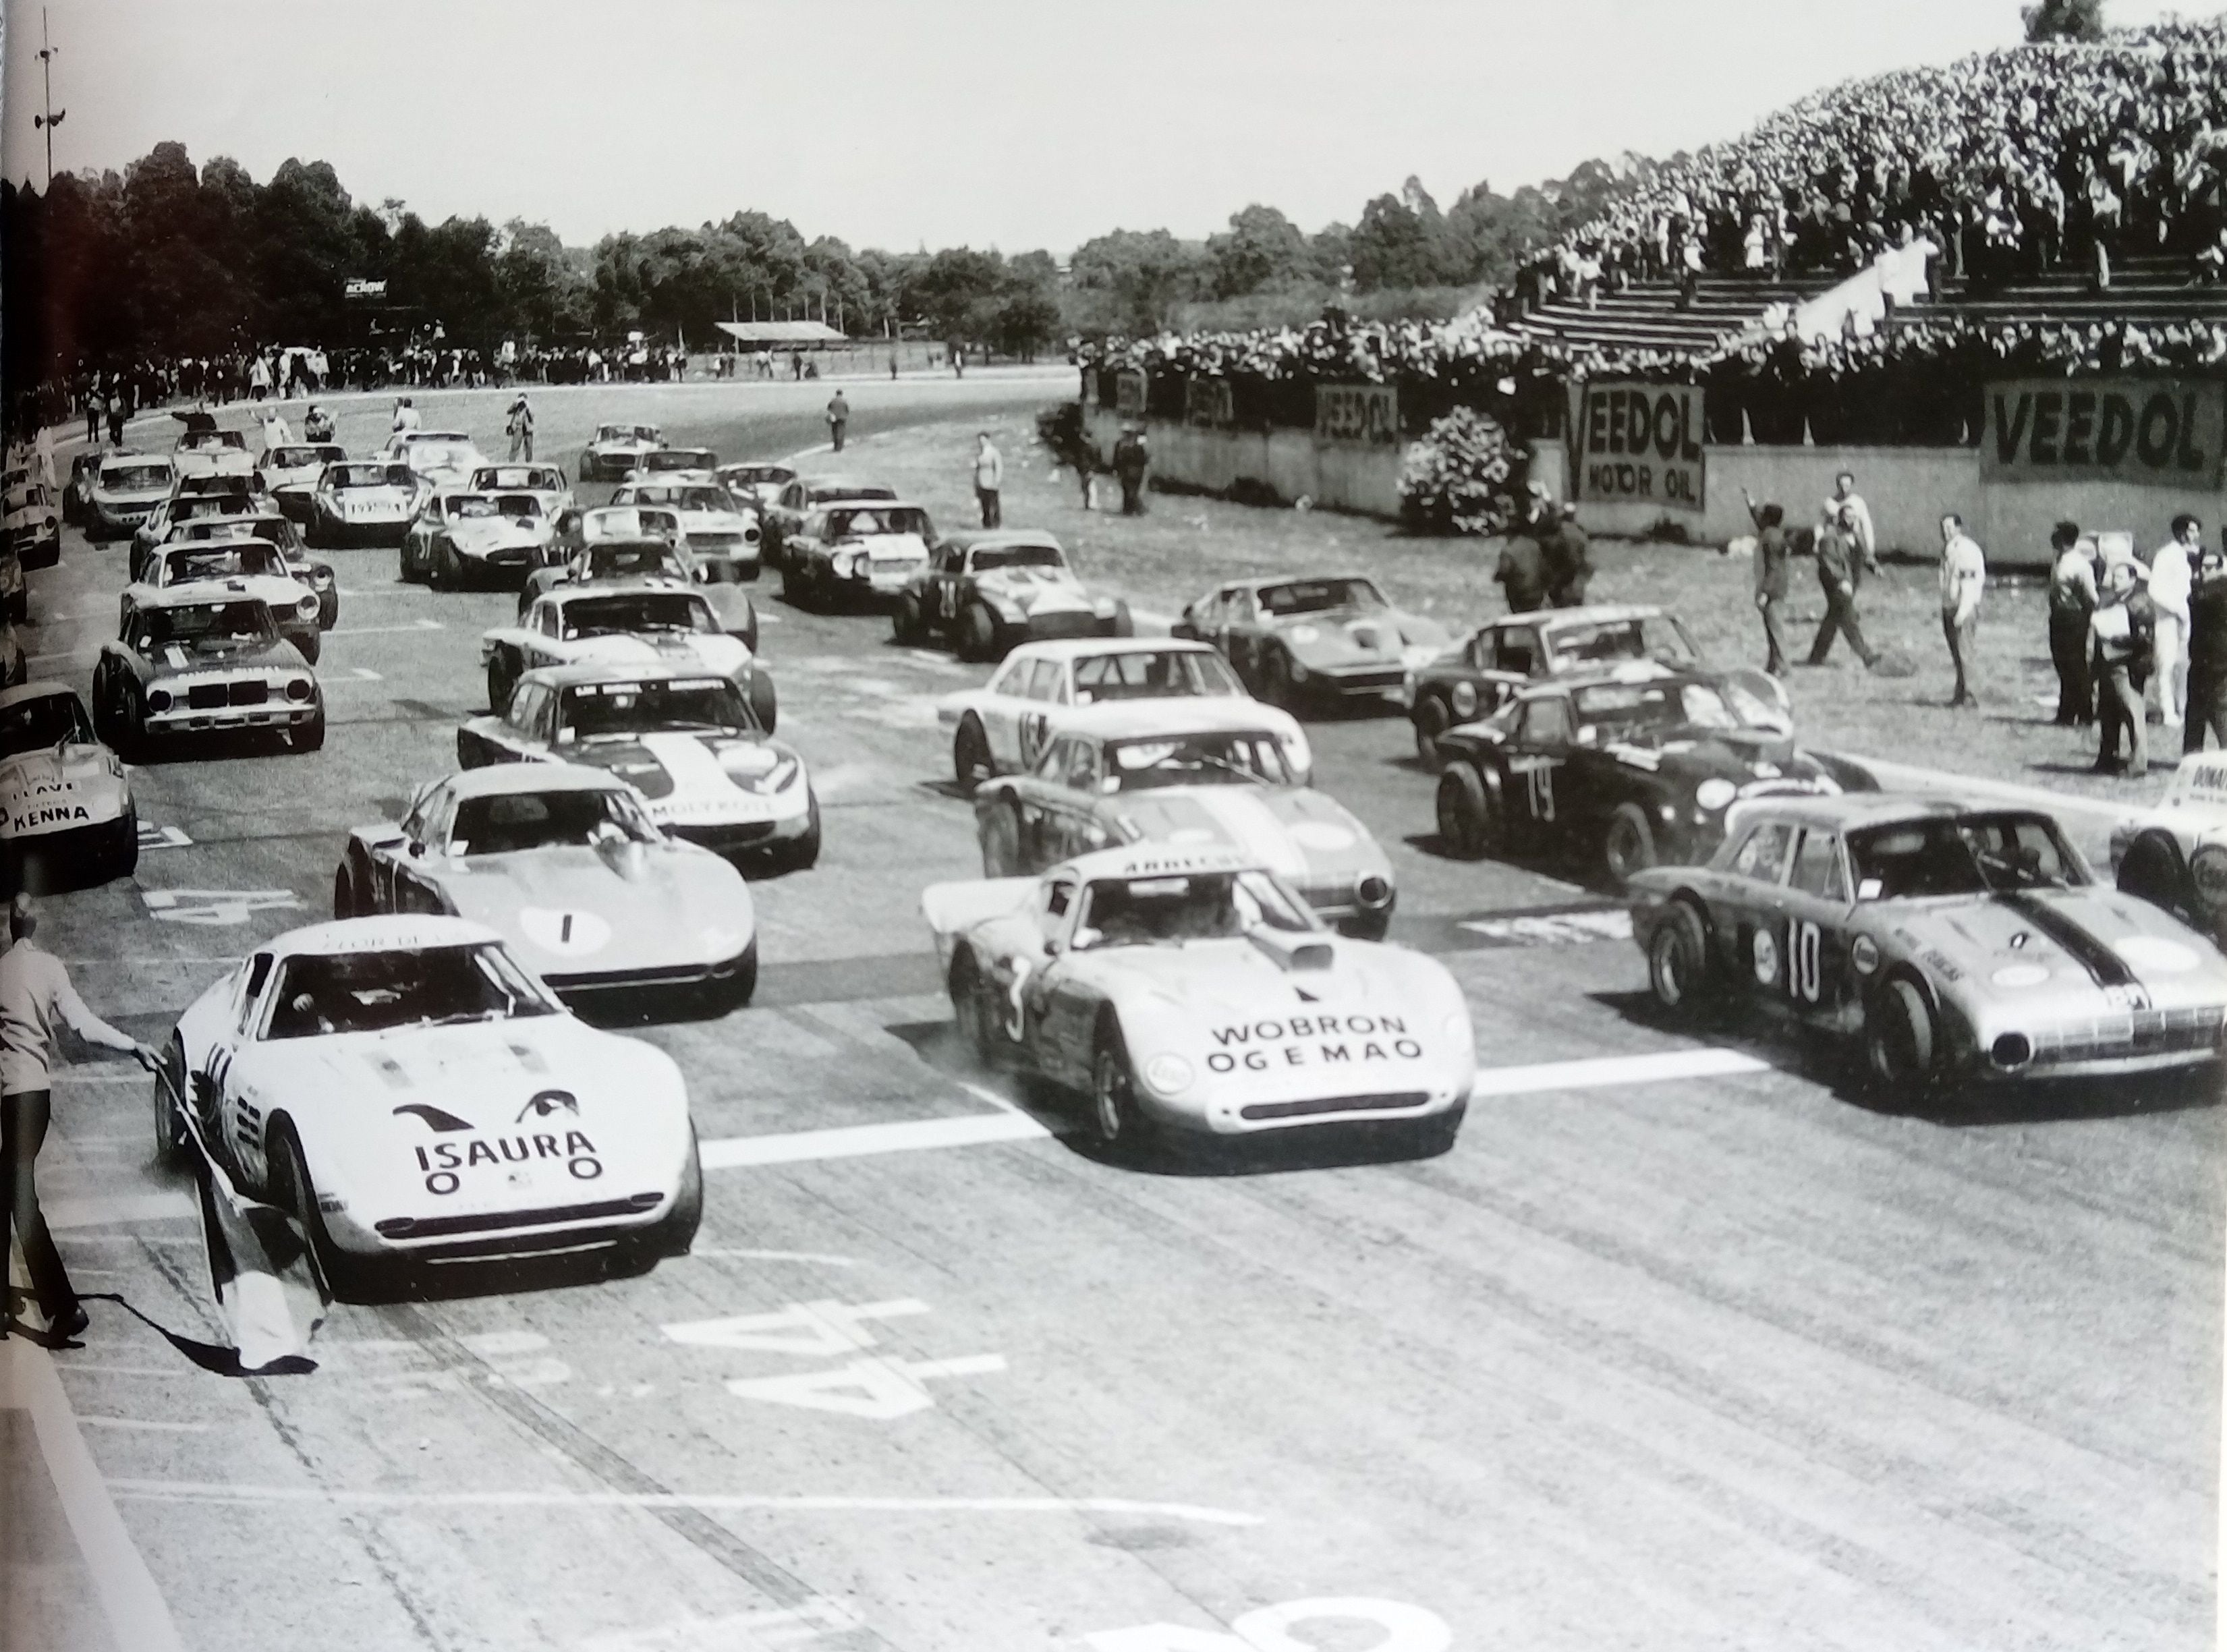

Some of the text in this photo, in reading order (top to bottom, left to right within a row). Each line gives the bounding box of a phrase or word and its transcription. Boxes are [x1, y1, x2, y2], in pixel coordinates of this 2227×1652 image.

[1562, 384, 1699, 500] VEEDOL
[1994, 391, 2203, 471] VEEDOL
[1589, 462, 1695, 503] MOTOR OIL
[13, 806, 90, 833] KENNA
[561, 914, 572, 944] 1
[1788, 917, 1820, 1003] 10
[1212, 1016, 1406, 1046] WOBRON
[414, 1131, 597, 1171] ISAURA
